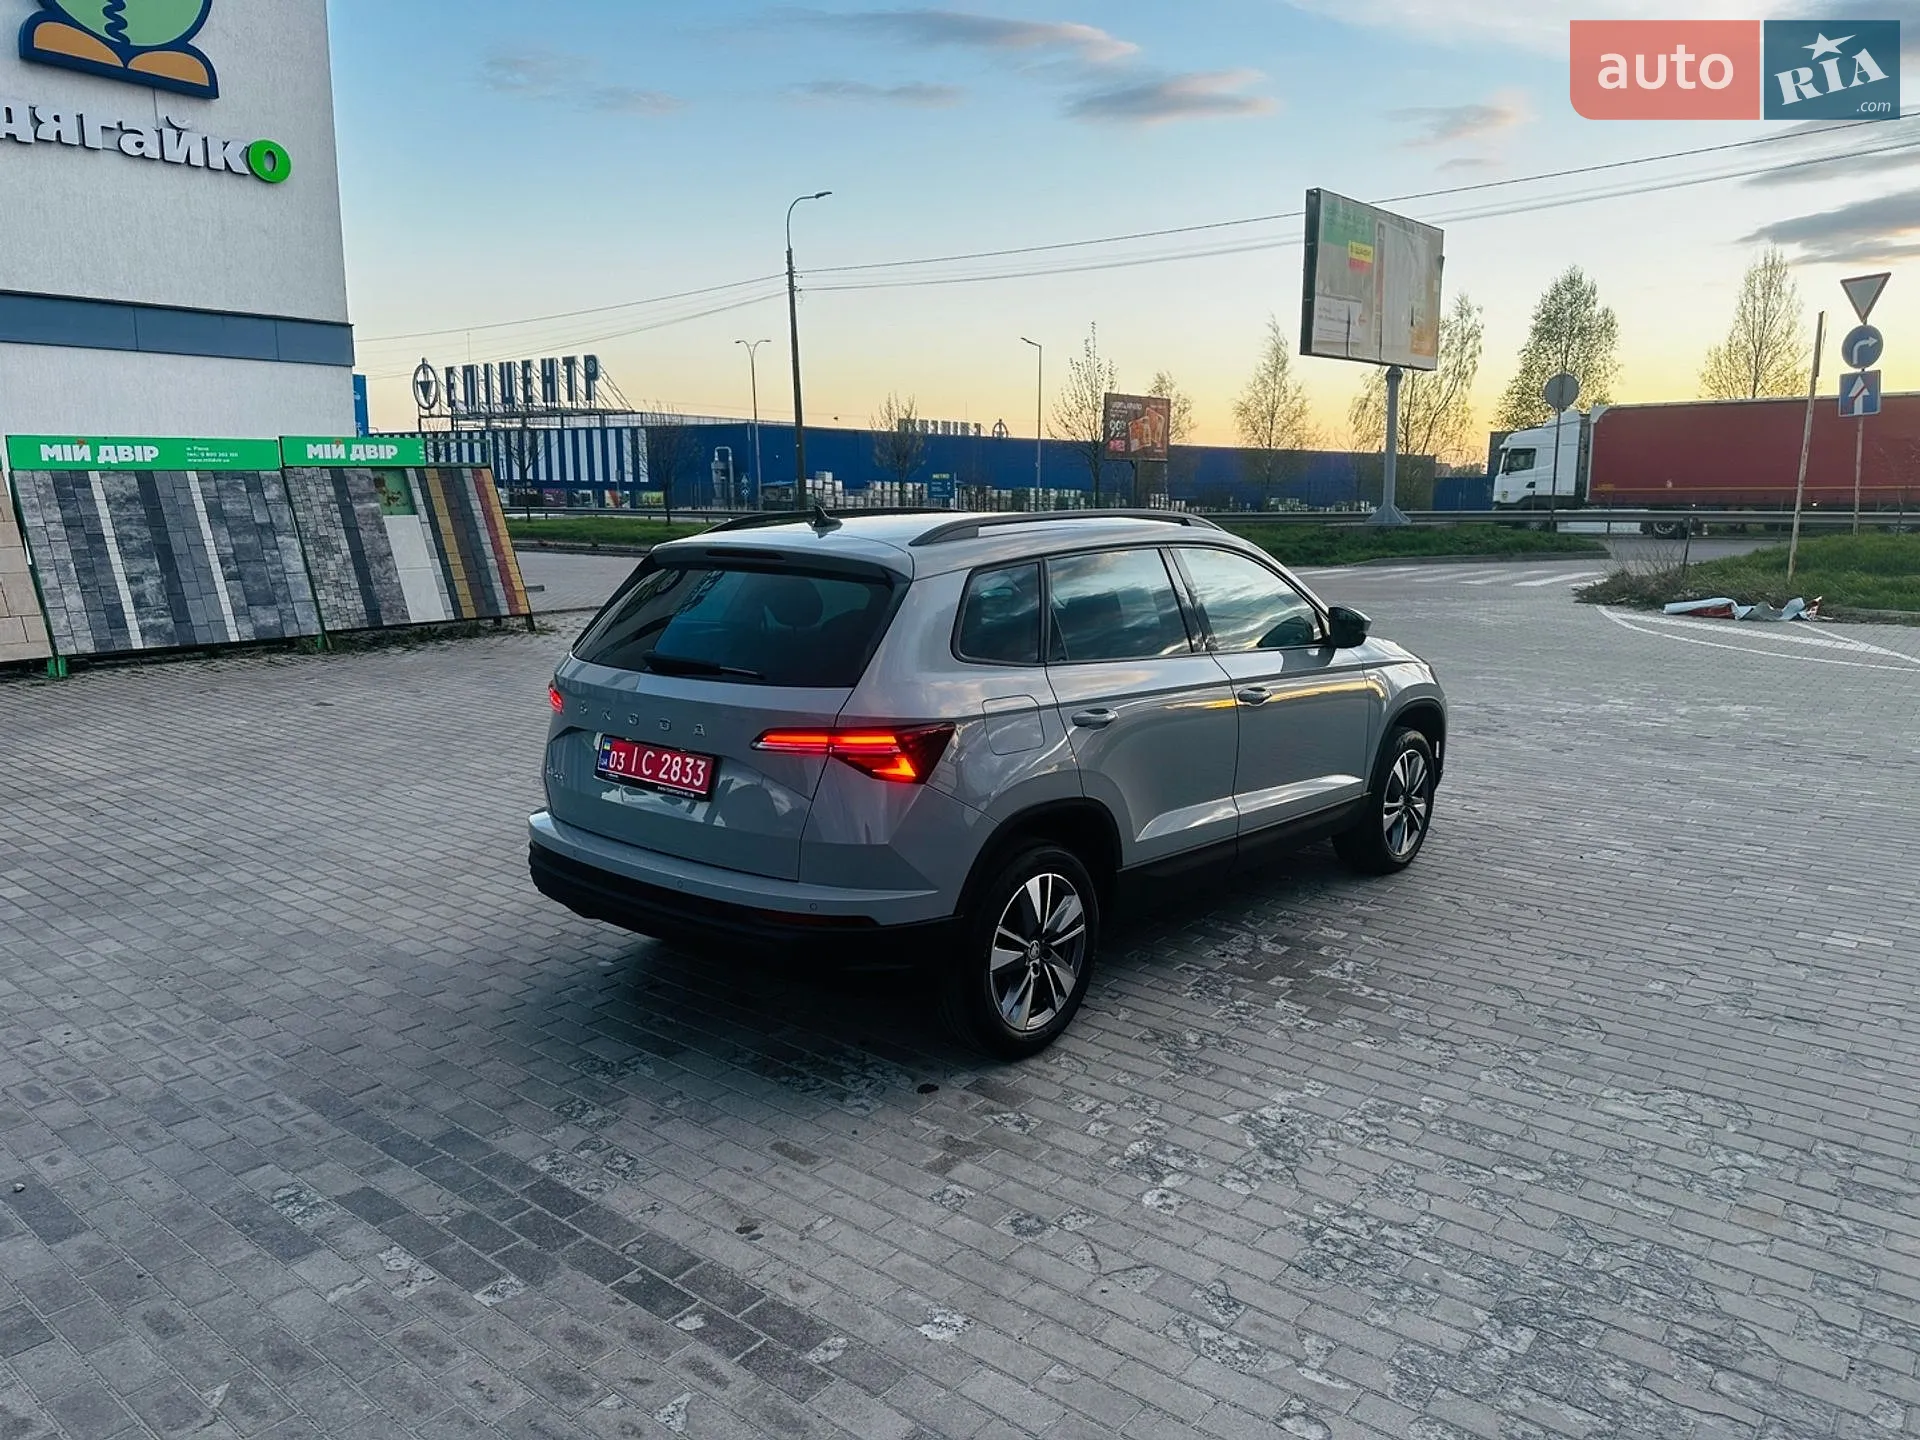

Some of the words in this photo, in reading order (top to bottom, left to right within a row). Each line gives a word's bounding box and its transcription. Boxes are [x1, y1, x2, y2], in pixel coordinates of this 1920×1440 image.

[445, 354, 600, 411] ЕПІЦЕНТР
[40, 440, 91, 462] МІЙ
[97, 445, 159, 463] ДВІР
[306, 440, 346, 460] МІЙ
[349, 444, 398, 461] ДВІР
[609, 750, 626, 771] 03
[658, 753, 706, 787] 2833
